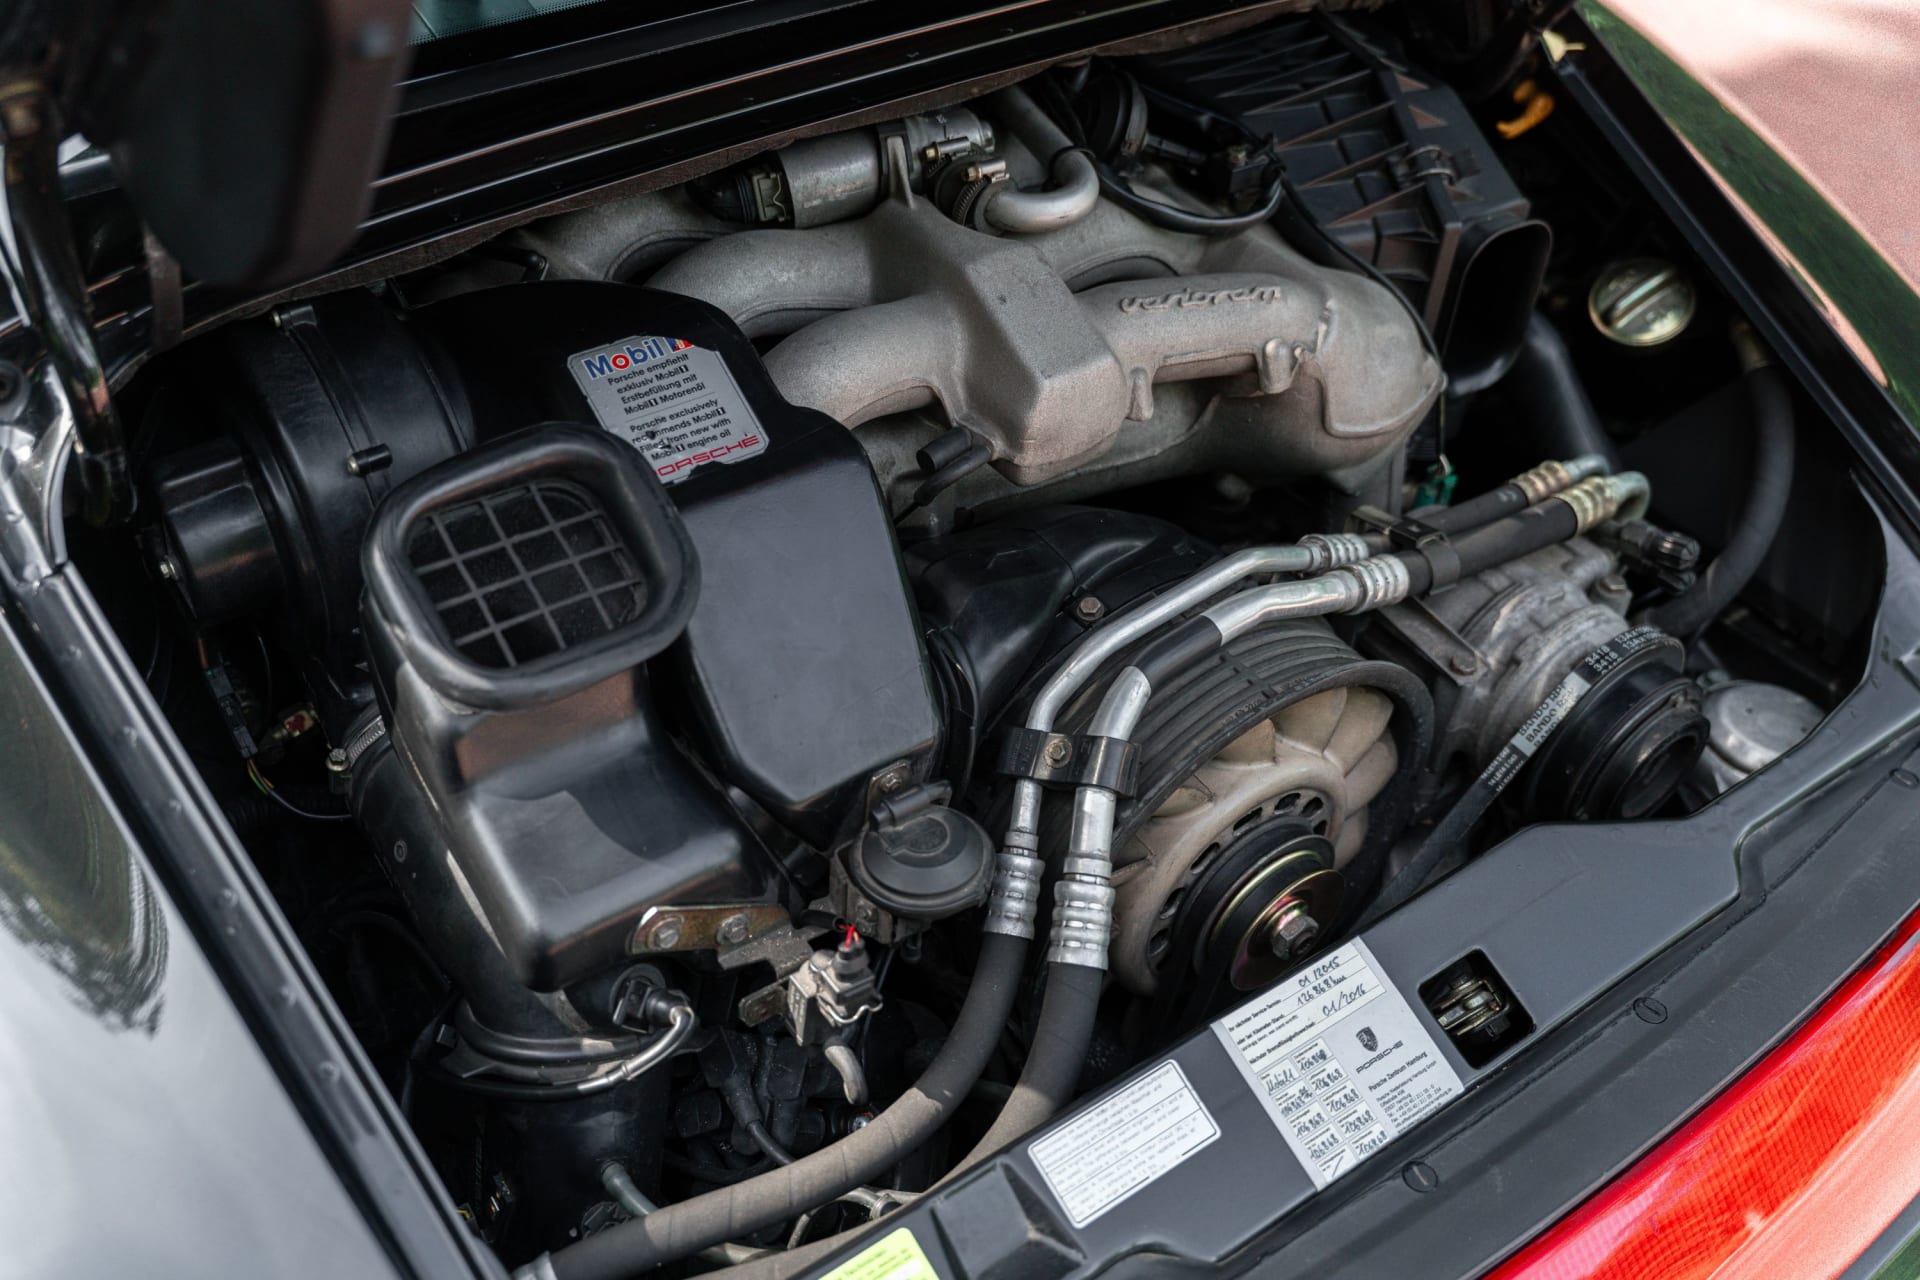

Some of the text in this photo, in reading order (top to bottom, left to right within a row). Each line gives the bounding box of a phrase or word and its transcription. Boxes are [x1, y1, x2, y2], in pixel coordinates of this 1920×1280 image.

[584, 339, 663, 377] Mobil
[607, 353, 689, 385] Porsche empfiehlt
[617, 378, 654, 394] exklusiv
[621, 374, 697, 404] Erstbefüllung mit
[659, 382, 706, 403] Motorenöl
[630, 399, 718, 432] Porsche exclusively
[632, 420, 692, 443] recmmends
[639, 439, 666, 454] Filled
[689, 426, 710, 437] new
[711, 418, 732, 429] with
[687, 435, 718, 449] engine
[719, 428, 731, 438] oil
[658, 435, 759, 476] ORSCHE
[1585, 646, 1611, 665] 3418
[1593, 652, 1618, 672] 3418
[1519, 703, 1549, 735] BANDO
[1526, 708, 1556, 743] BANDO
[1356, 1040, 1404, 1074] PORSCHE
[1368, 1051, 1428, 1092] Porsche Zentrum Hamburg
